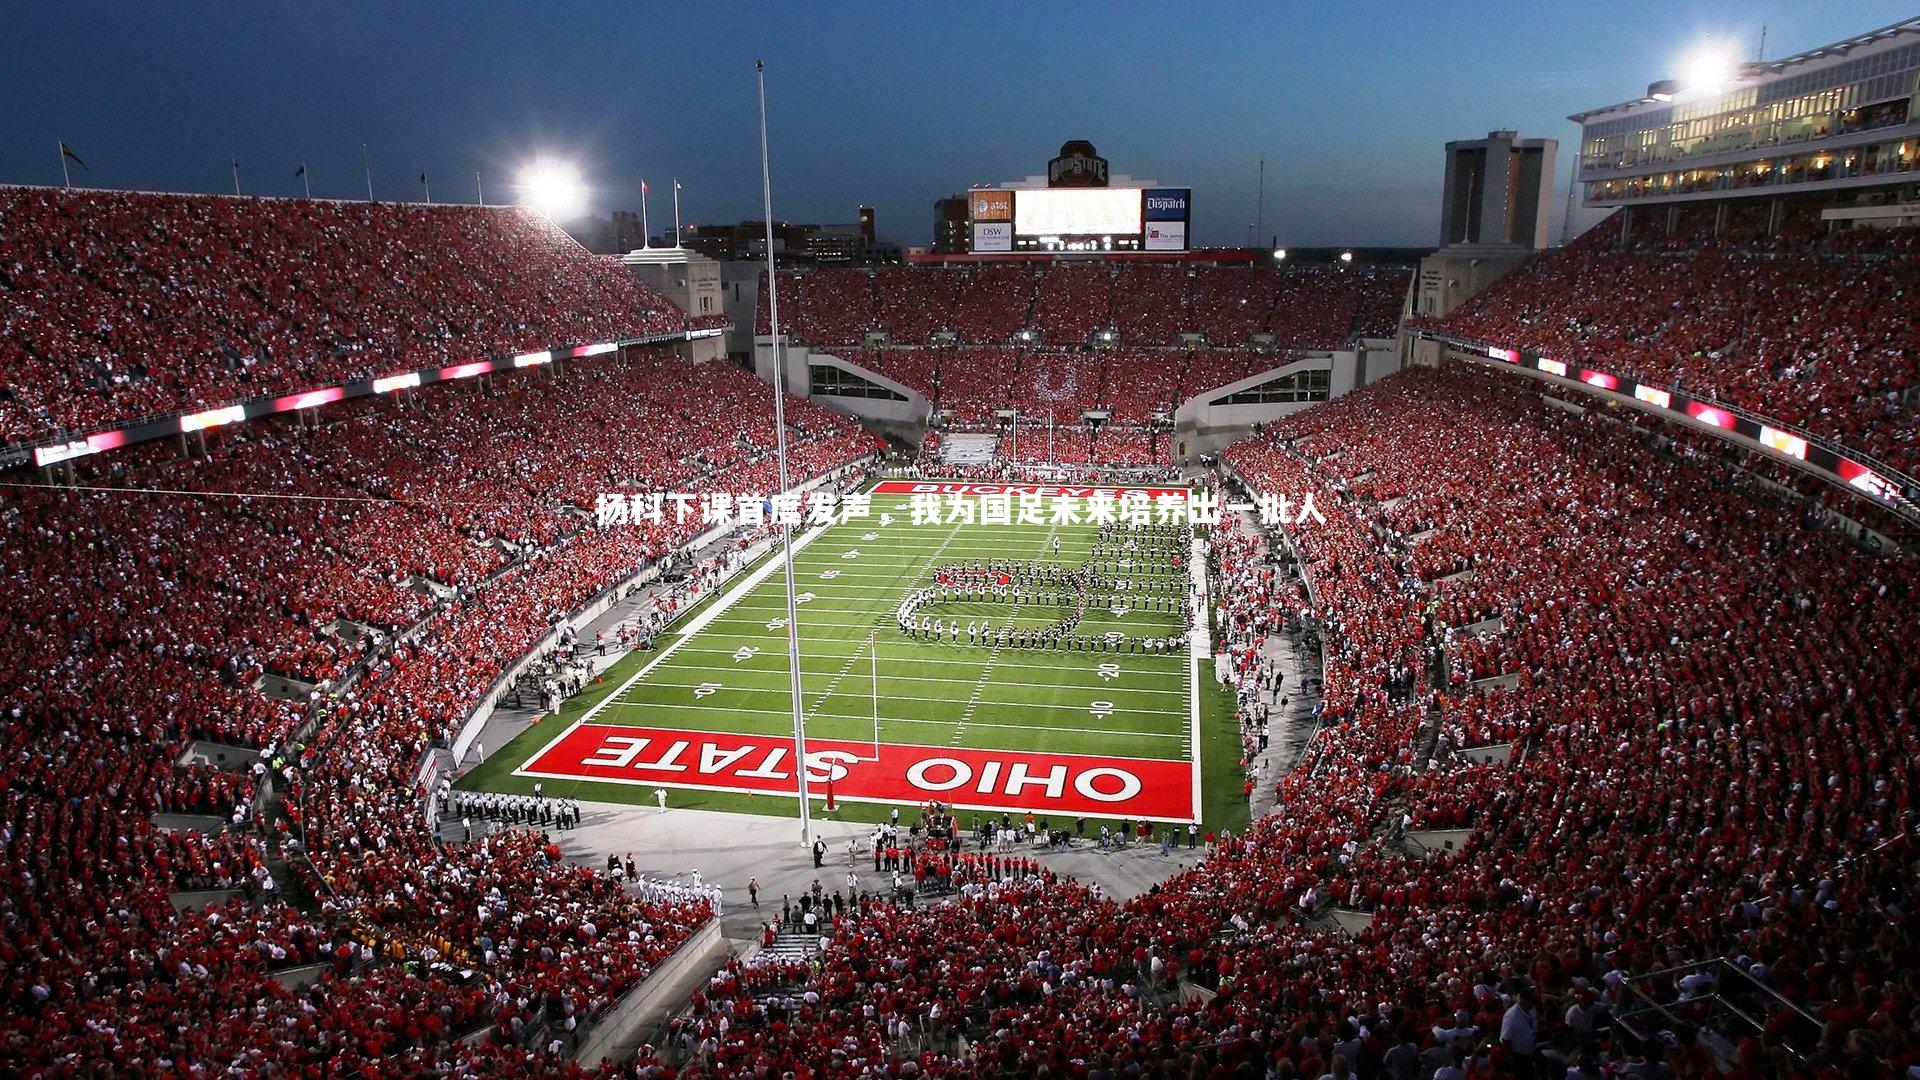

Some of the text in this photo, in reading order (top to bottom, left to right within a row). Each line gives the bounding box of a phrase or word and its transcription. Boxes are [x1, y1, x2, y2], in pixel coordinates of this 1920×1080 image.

[1147, 197, 1185, 210] Dispatch
[911, 484, 1148, 498] BUCKEYES
[1098, 664, 1119, 677] 20
[694, 683, 722, 695] 10
[1089, 701, 1113, 714] 10
[580, 736, 1142, 802] OHIO STATE
